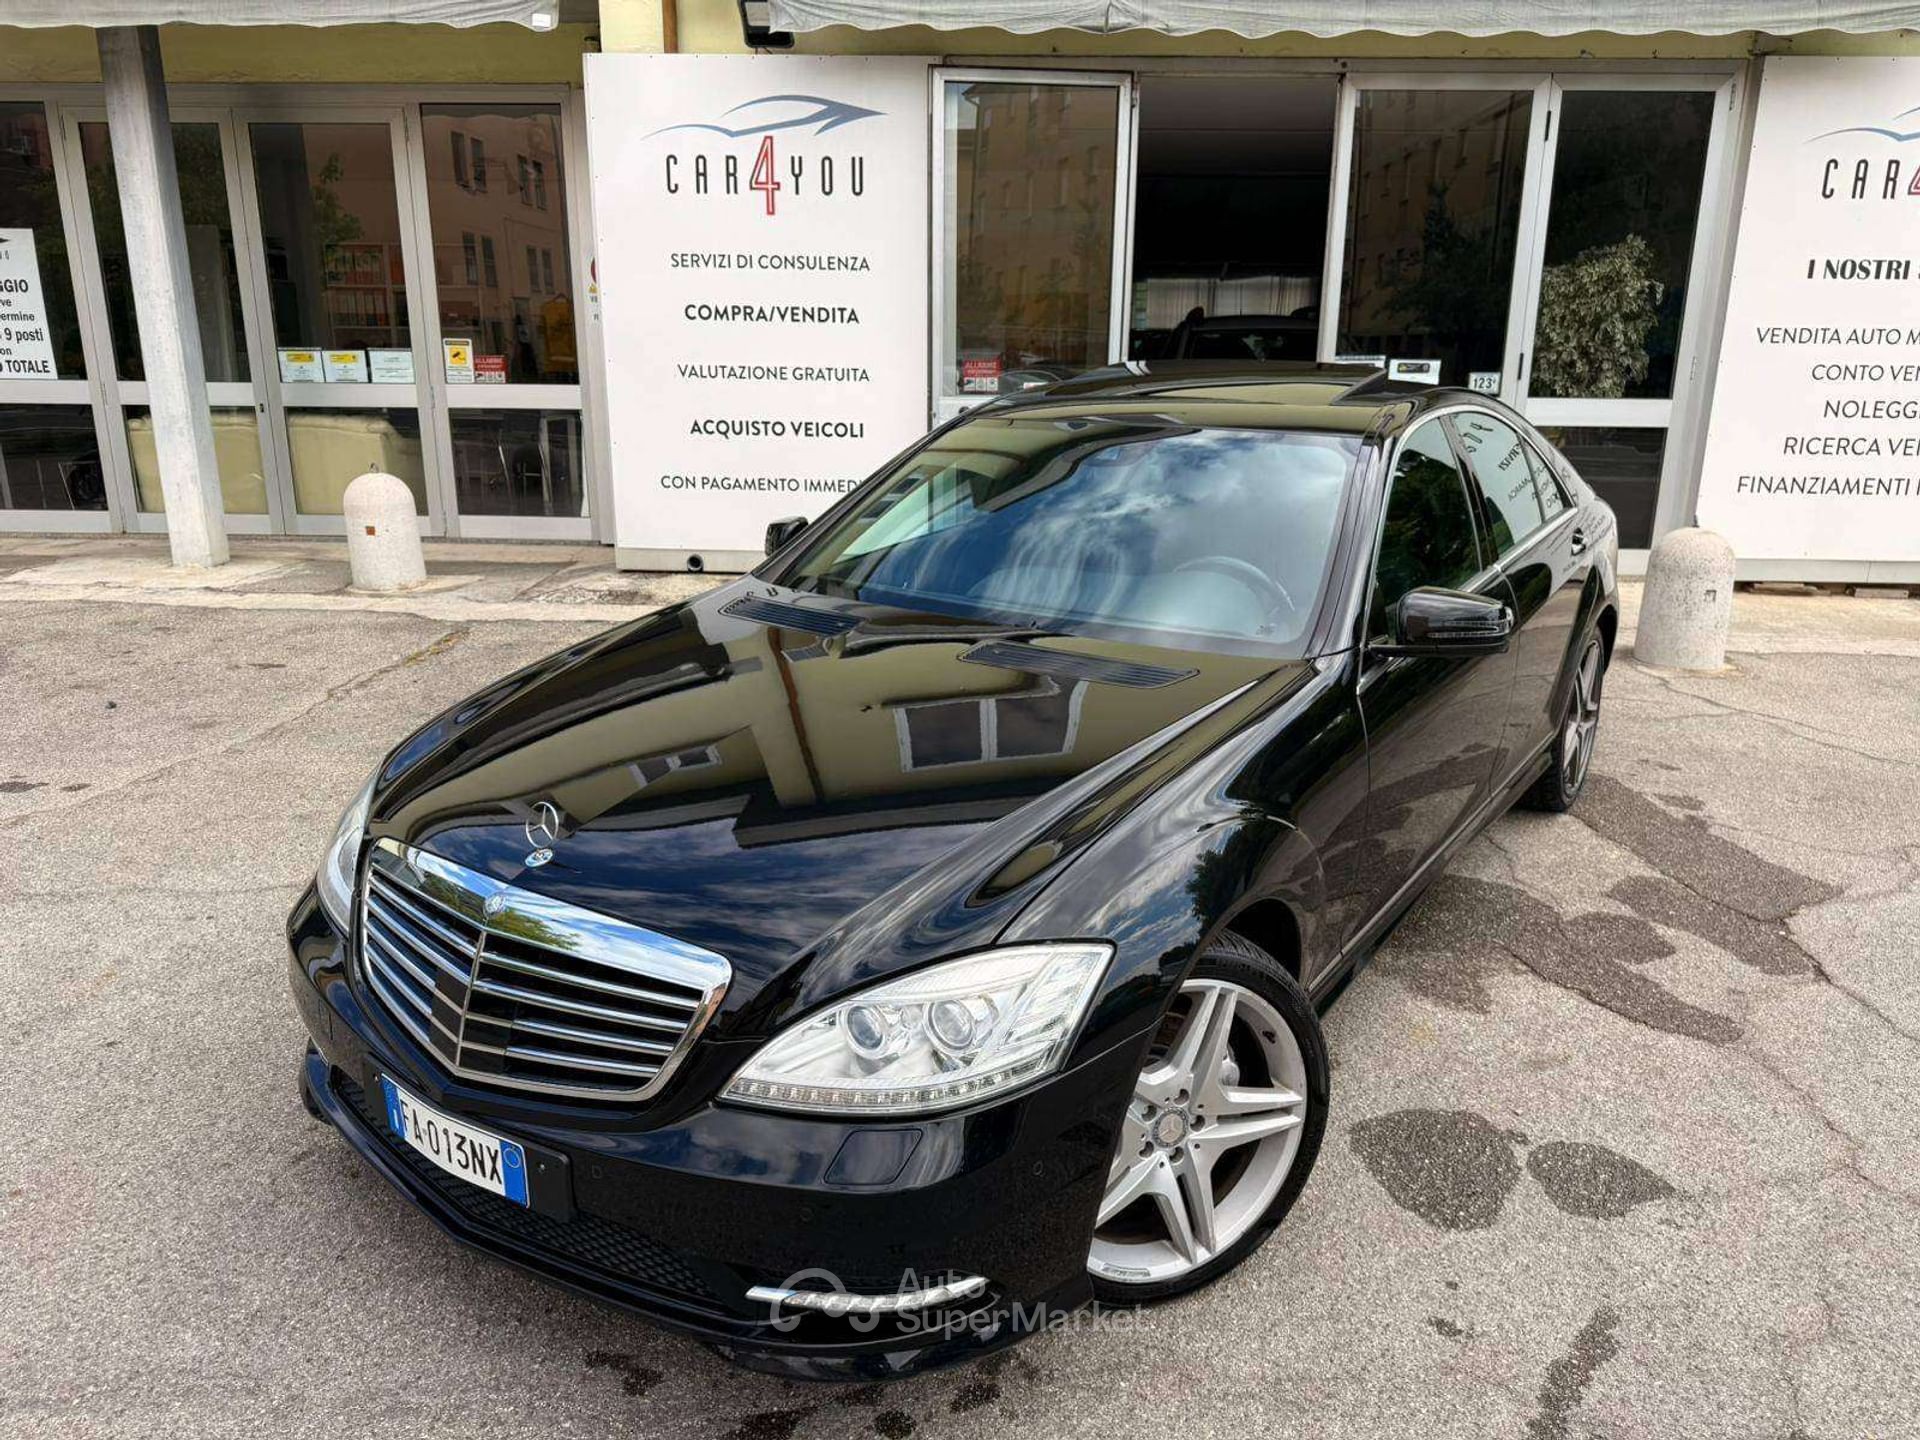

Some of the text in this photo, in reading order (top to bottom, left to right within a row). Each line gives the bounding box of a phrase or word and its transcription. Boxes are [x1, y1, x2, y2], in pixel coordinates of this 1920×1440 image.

[670, 253, 871, 272] SERVIZI DI CONSULENZA
[1807, 259, 1816, 279] I
[1823, 259, 1911, 280] NOSTRI
[684, 304, 860, 325] COMPRA/VENDITA
[4, 327, 44, 344] 9 posti
[1756, 327, 1842, 345] VENDITA
[1846, 328, 1901, 345] AUTO
[5, 359, 51, 374] TOTALE
[677, 364, 870, 382] VALUTAZIONE GRATUITA
[1811, 364, 1884, 381] CONTO
[1824, 400, 1920, 419] NOLEGG
[690, 419, 864, 440] ACQUISTO VEICOLI
[1783, 437, 1881, 456] RICERCA
[660, 475, 863, 493] CON PAGAMENTO IMMED
[1737, 476, 1911, 496] FINANZIAMENTI
